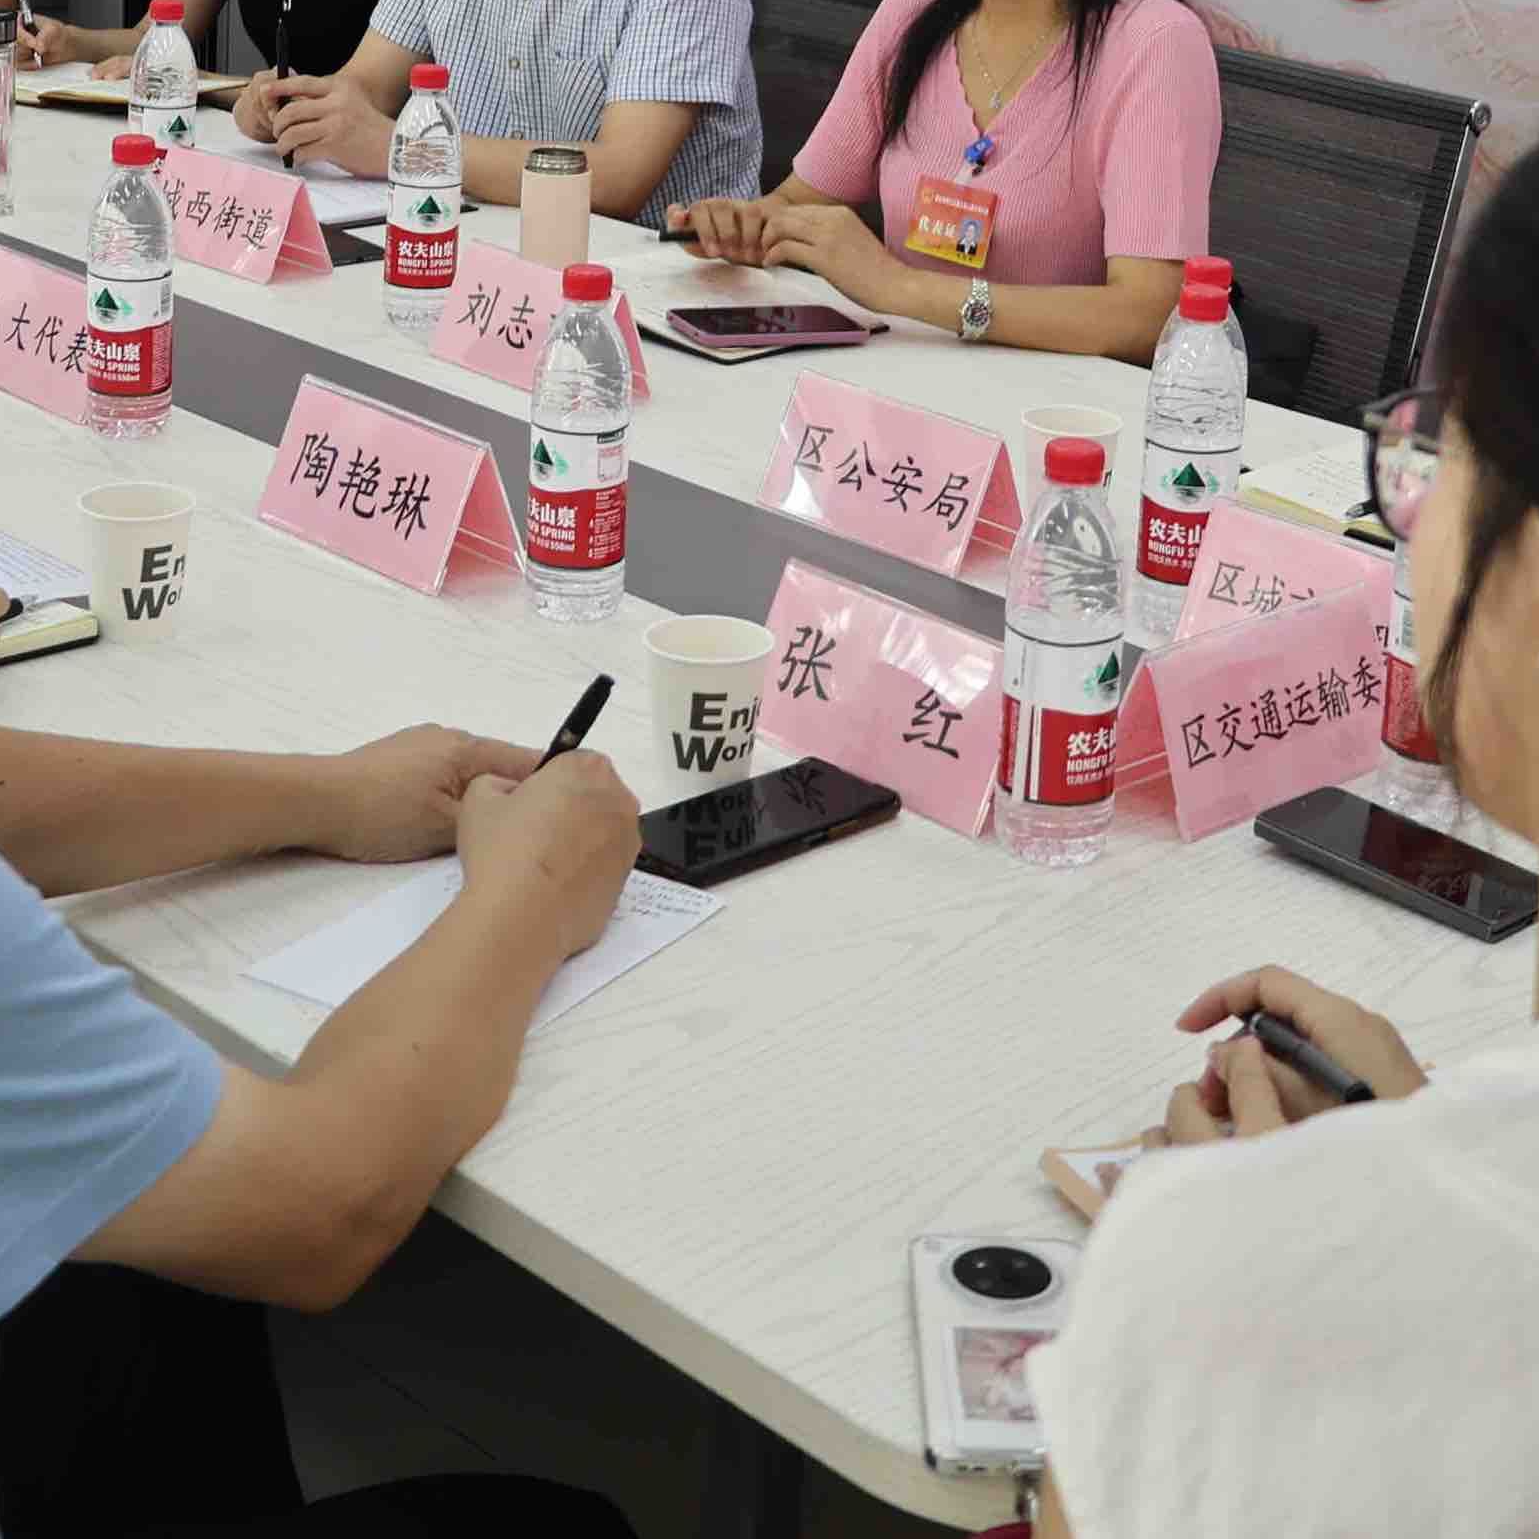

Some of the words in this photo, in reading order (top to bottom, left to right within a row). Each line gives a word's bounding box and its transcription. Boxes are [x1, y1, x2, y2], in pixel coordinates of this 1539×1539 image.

[457, 282, 556, 349] 刘志
[290, 432, 432, 541] 陶艳琳
[792, 425, 970, 533] 区公安局
[528, 496, 576, 528] 夫山泉
[541, 526, 576, 542] SPRING
[1208, 561, 1314, 612] 区城
[689, 692, 761, 733] Enj
[780, 625, 834, 704] 张
[903, 688, 965, 759] 红
[1182, 654, 1381, 768] 区交通运输委
[1067, 727, 1116, 756] 农夫
